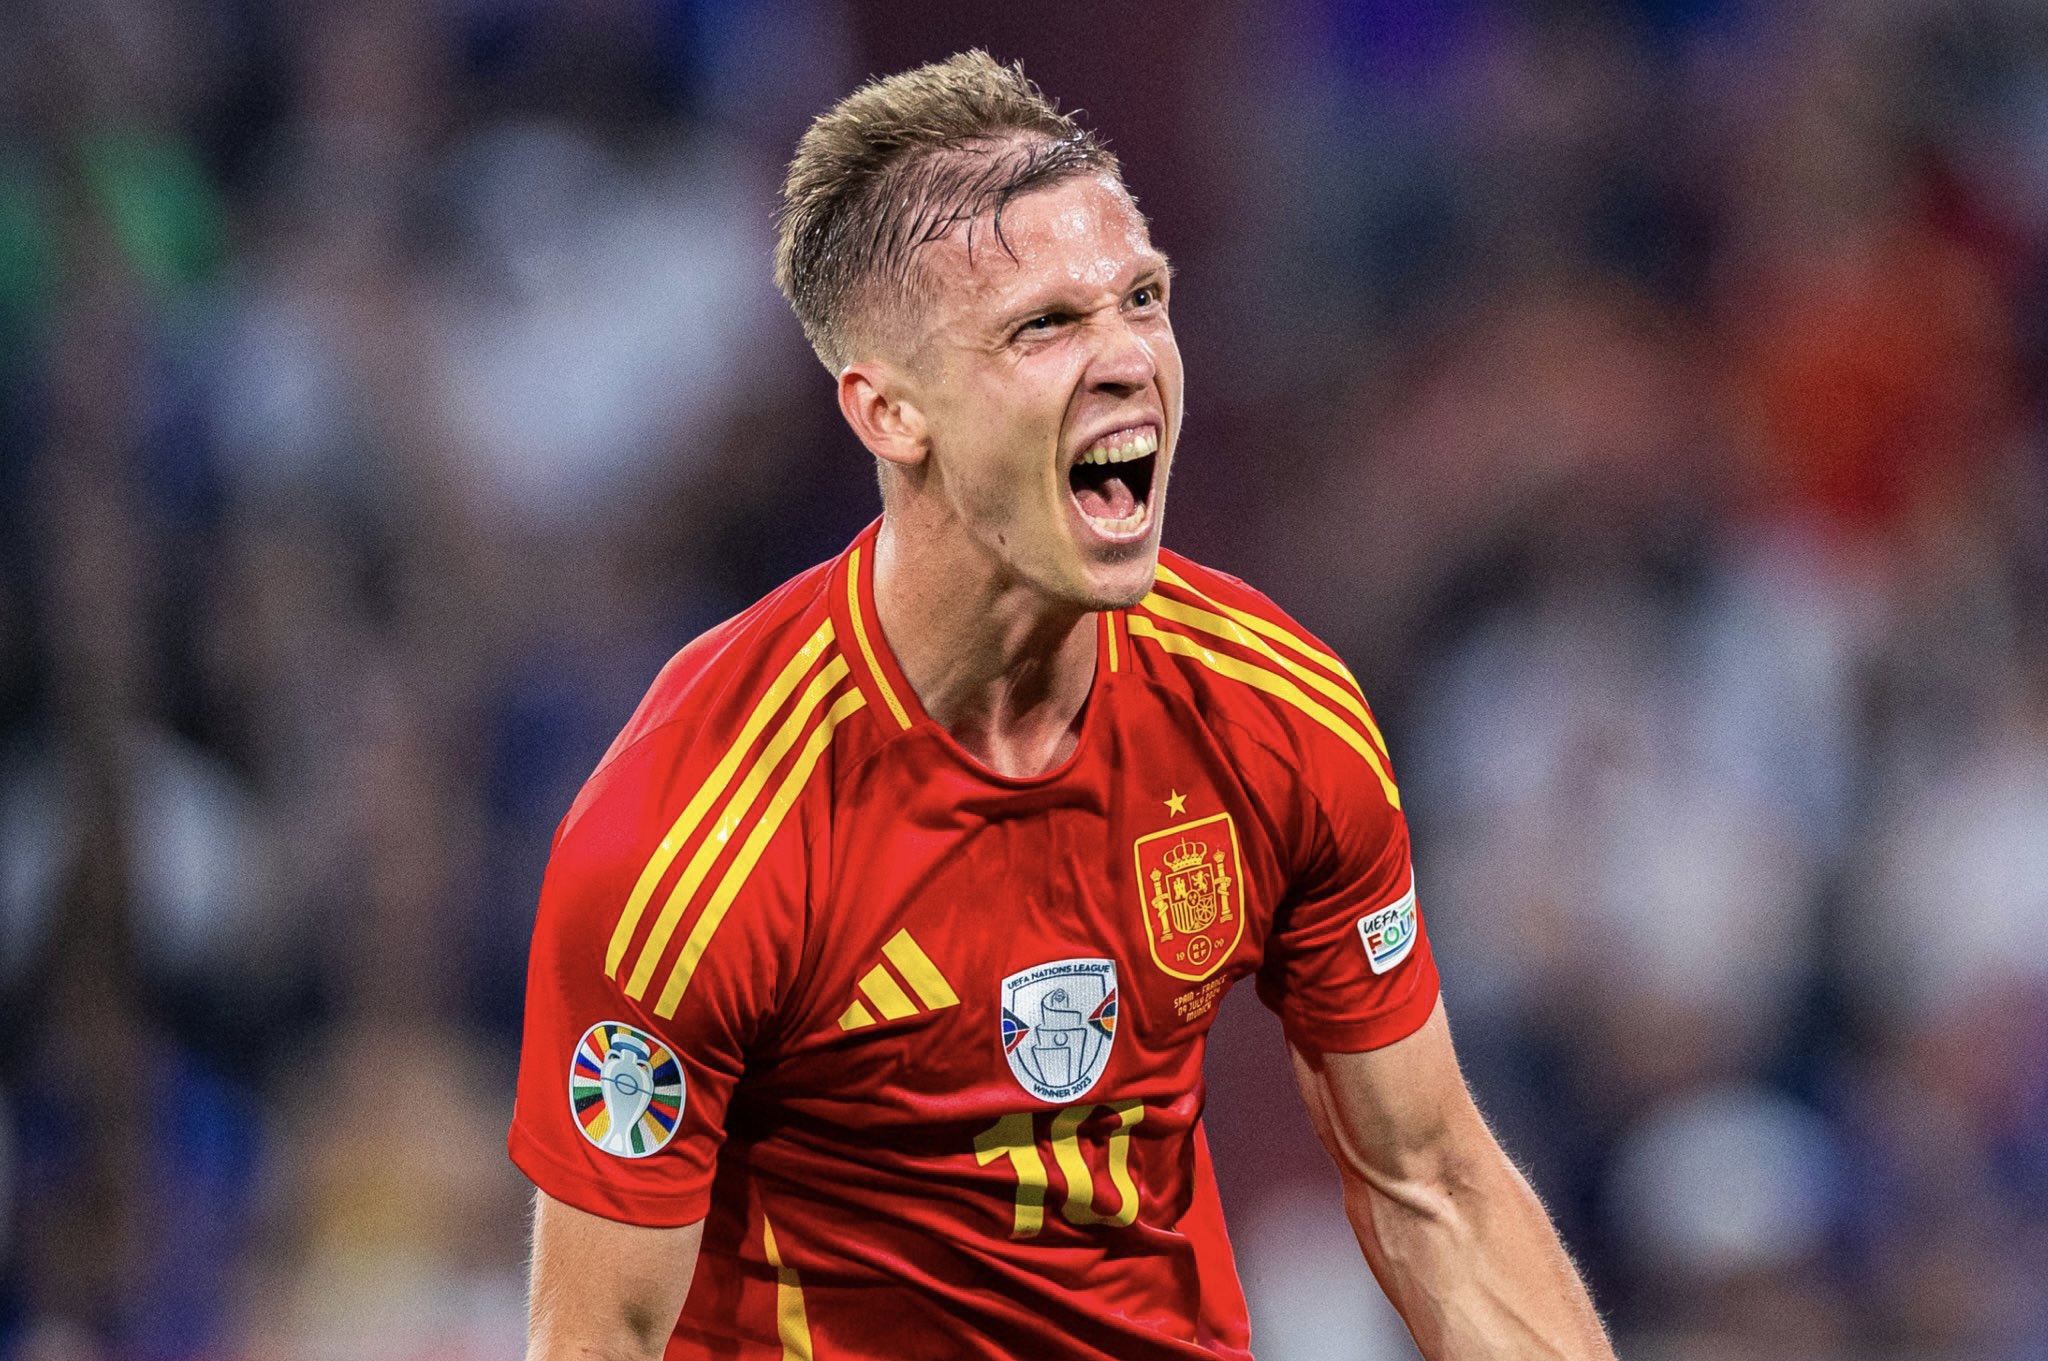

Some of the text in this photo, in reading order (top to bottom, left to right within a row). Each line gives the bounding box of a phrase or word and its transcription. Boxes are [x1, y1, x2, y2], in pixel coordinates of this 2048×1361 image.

[1364, 910, 1398, 933] UEFA
[1007, 963, 1110, 989] UEFA NATIONS LEAGUE
[1174, 991, 1194, 1008] SPAIN
[1033, 1076, 1092, 1098] WINNER 2023
[973, 1098, 1144, 1240] 10
